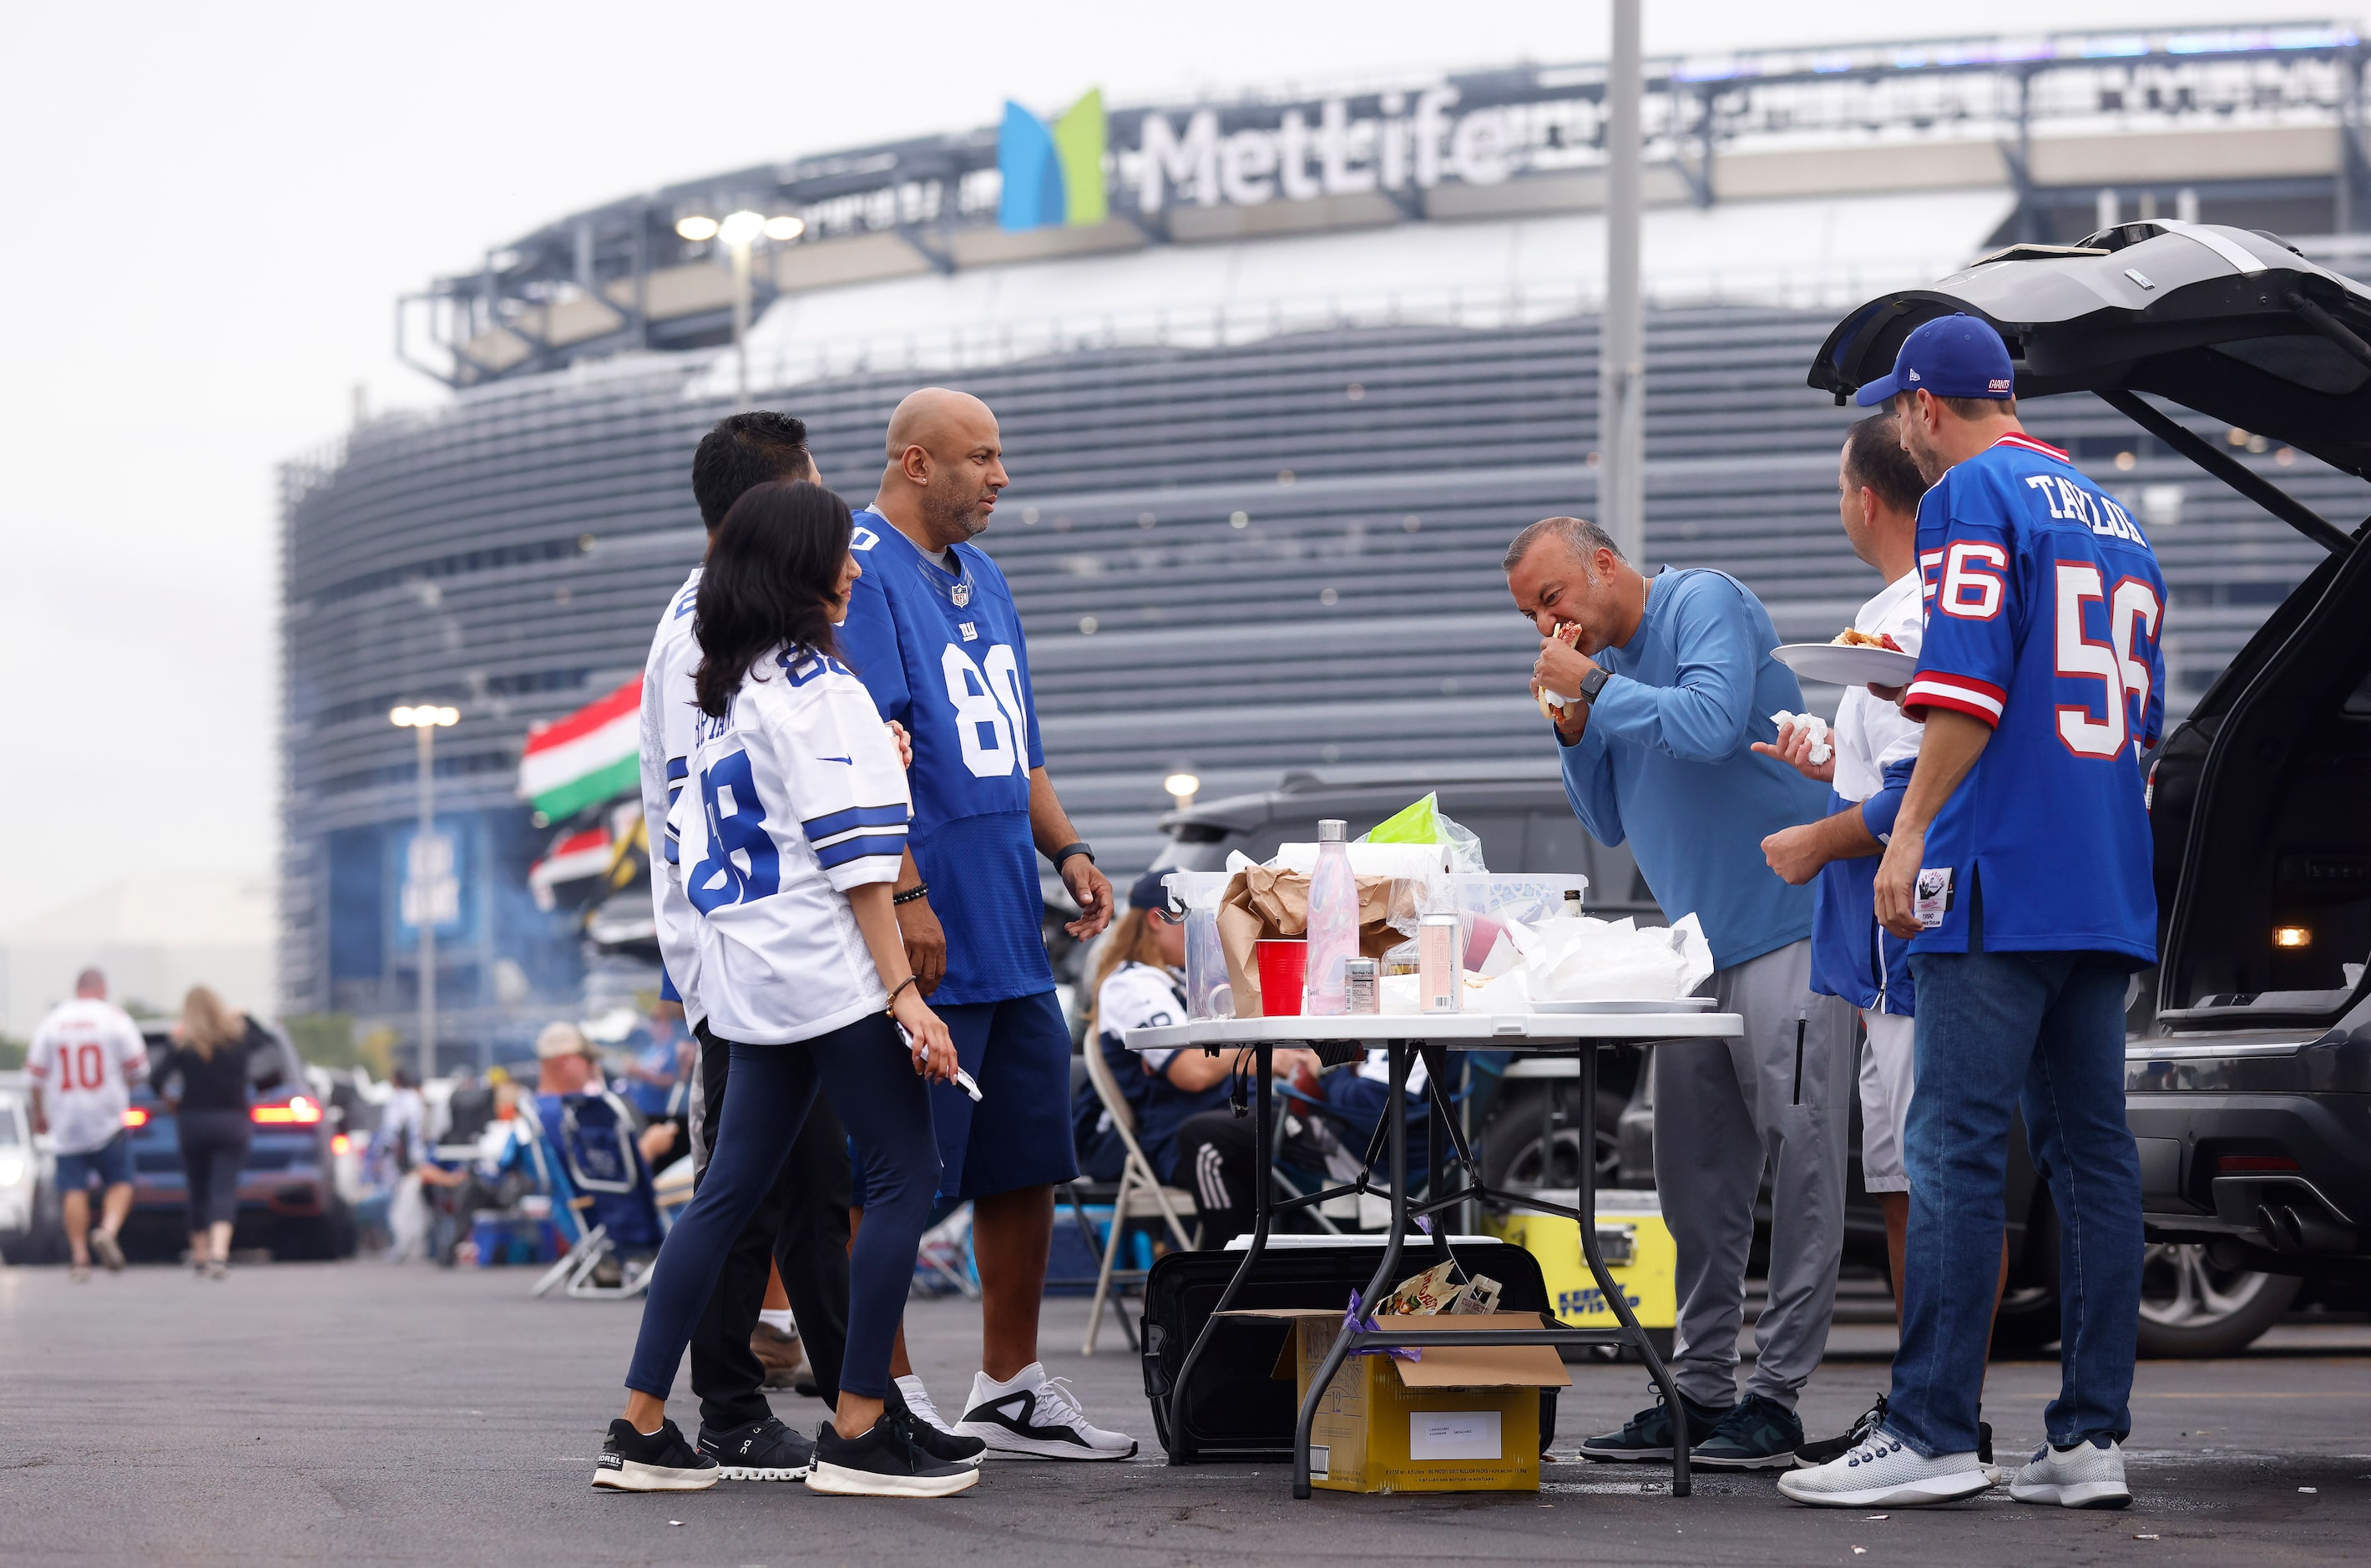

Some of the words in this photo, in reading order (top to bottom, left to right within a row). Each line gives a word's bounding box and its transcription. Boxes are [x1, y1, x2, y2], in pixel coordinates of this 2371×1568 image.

[1139, 86, 1513, 213] MetLife
[1989, 379, 2010, 390] GIANTS
[2025, 474, 2148, 549] TAYLOR
[954, 594, 968, 604] NFL
[2054, 559, 2165, 765] 56
[941, 643, 1031, 781] 80
[688, 749, 781, 918] 88
[58, 1043, 105, 1093] 10
[1560, 1296, 1640, 1317] TWISD
